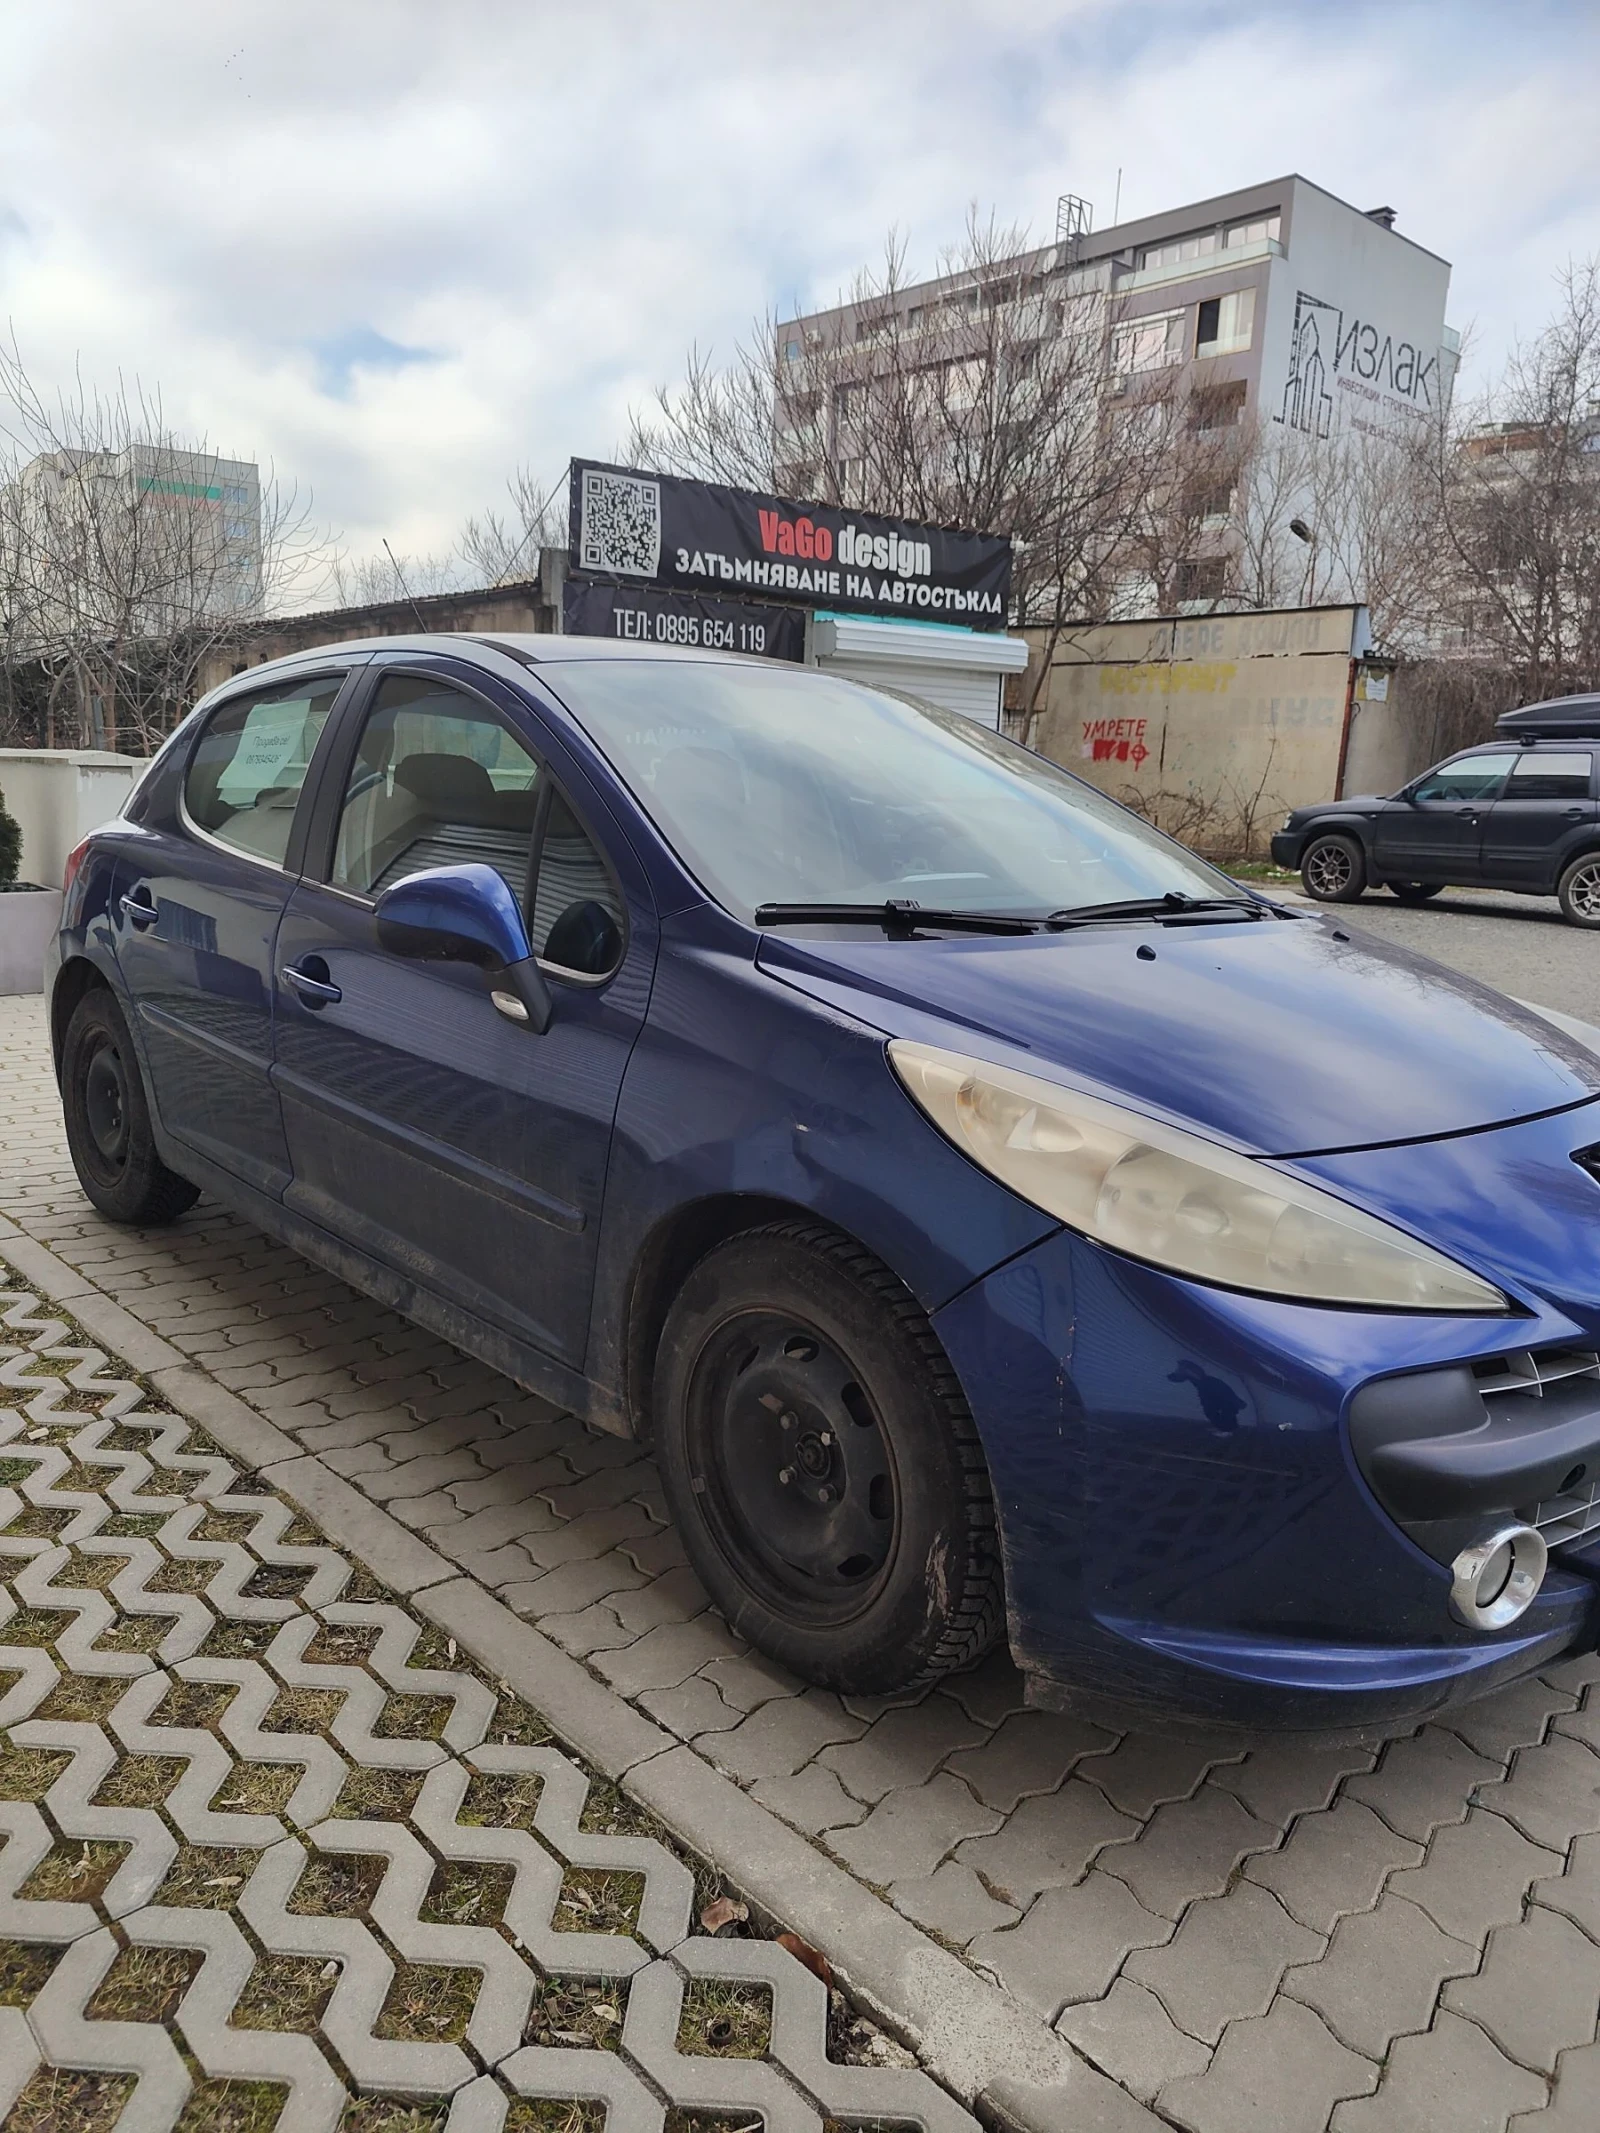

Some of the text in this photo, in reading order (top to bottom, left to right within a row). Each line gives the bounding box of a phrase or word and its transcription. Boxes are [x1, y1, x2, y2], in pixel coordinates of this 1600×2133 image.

[758, 509, 931, 578] VaGo design
[675, 548, 1003, 614] ЗАТЪМНЯВАНЕ НА АВТОСТЪКЛА
[613, 608, 765, 651] ТЕЛ: 0895 654 119
[1082, 718, 1147, 740] УМРЕТЕ
